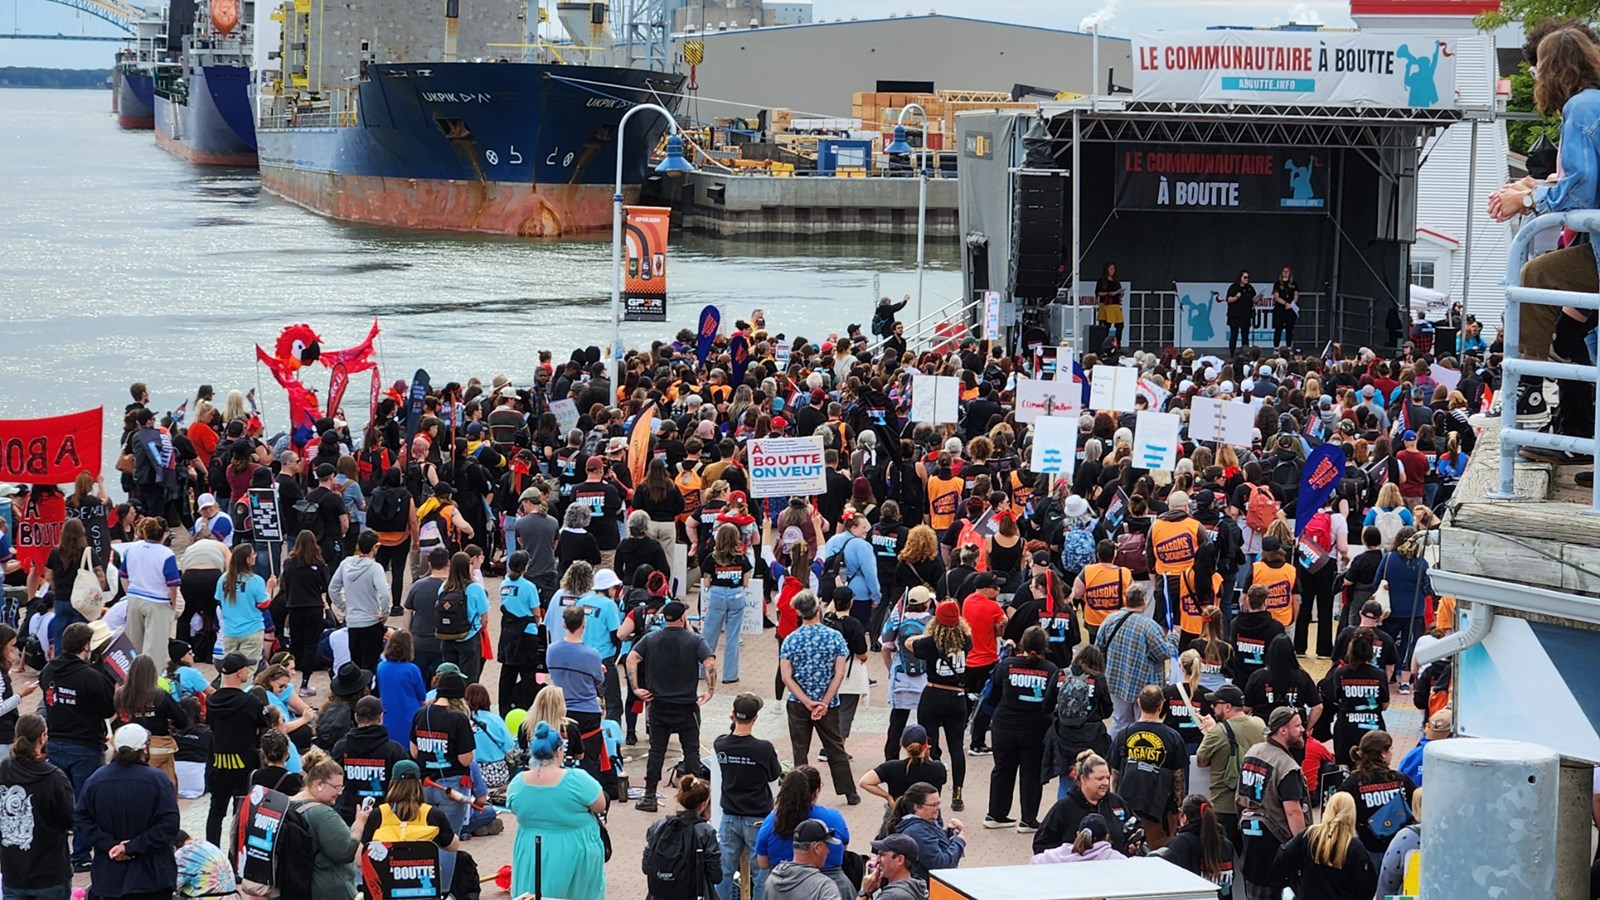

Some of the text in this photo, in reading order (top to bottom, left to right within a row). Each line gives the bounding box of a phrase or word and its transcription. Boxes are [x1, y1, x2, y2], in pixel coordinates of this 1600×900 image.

[1139, 40, 1394, 74] LE COMMUNAUTAIRE À BOUTTE
[1238, 78, 1295, 90] ABOUTTE.INFO
[422, 92, 459, 103] UKPIK
[586, 98, 615, 109] UKPIK
[1124, 151, 1273, 175] LE COMMUNAUTAIRE
[1157, 175, 1240, 206] À BOUTTE
[627, 298, 663, 307] GP3R
[752, 442, 763, 455] À
[753, 454, 821, 467] BOUTTE
[752, 465, 823, 478] ON VEUT
[1157, 536, 1190, 552] MAISONS
[1087, 585, 1119, 598] MAISONS
[1269, 584, 1288, 598] SONS
[1127, 748, 1162, 762] AGAST
